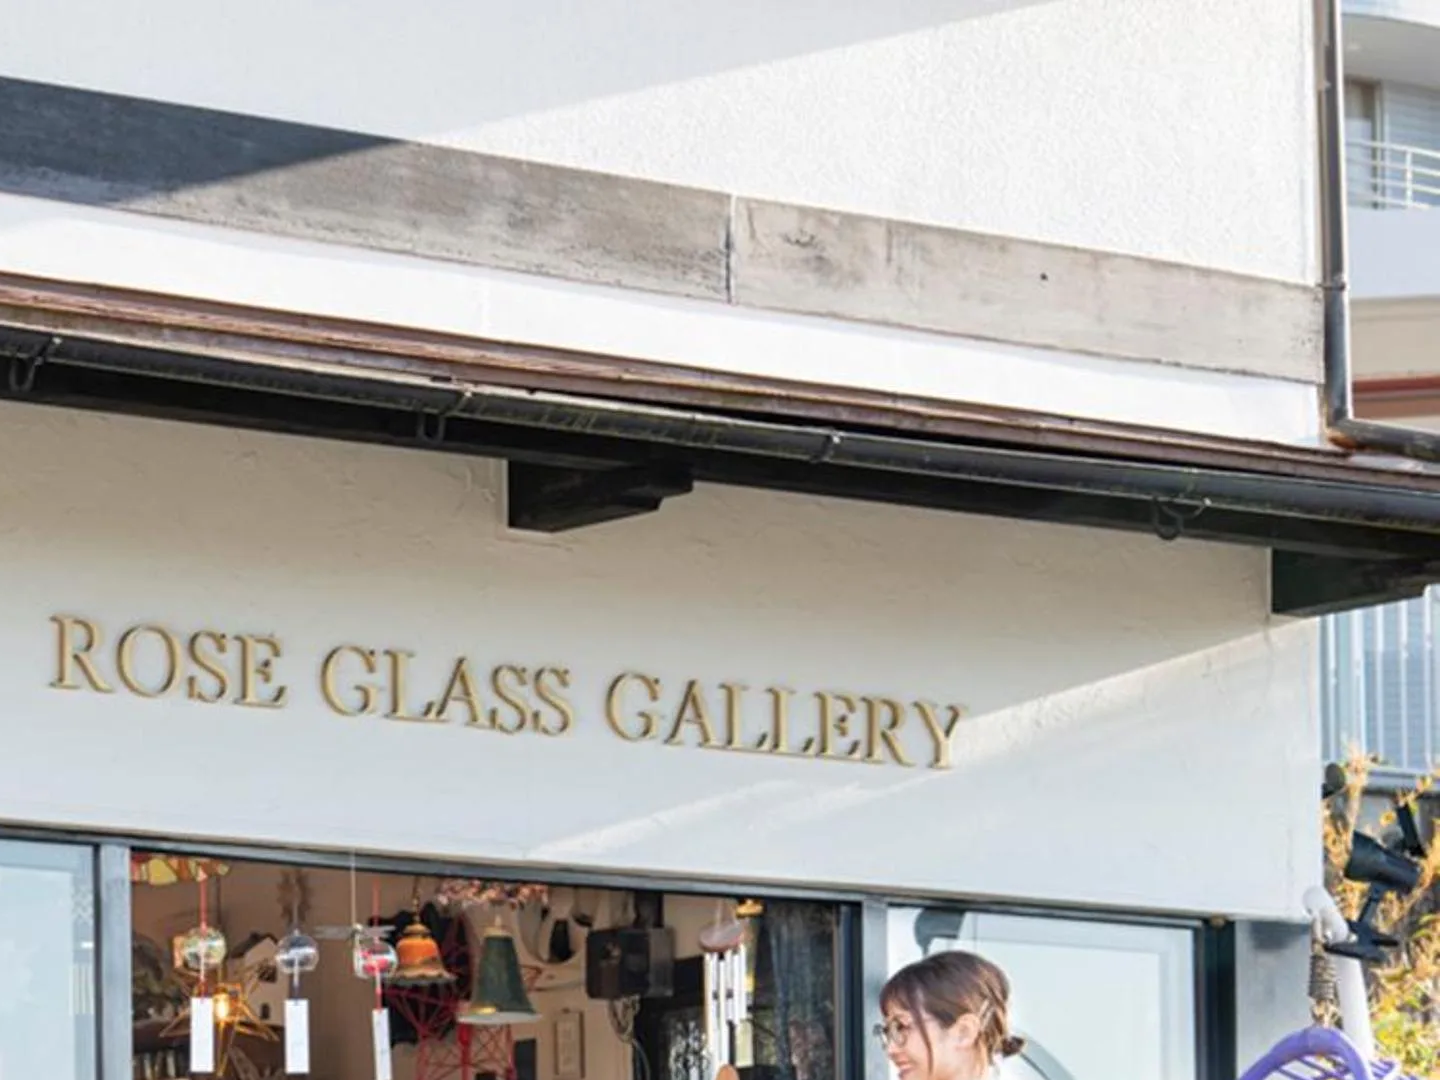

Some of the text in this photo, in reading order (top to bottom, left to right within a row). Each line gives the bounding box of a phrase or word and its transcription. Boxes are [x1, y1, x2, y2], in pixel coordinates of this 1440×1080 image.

[48, 613, 970, 771] ROSE GLASS GALLERY
